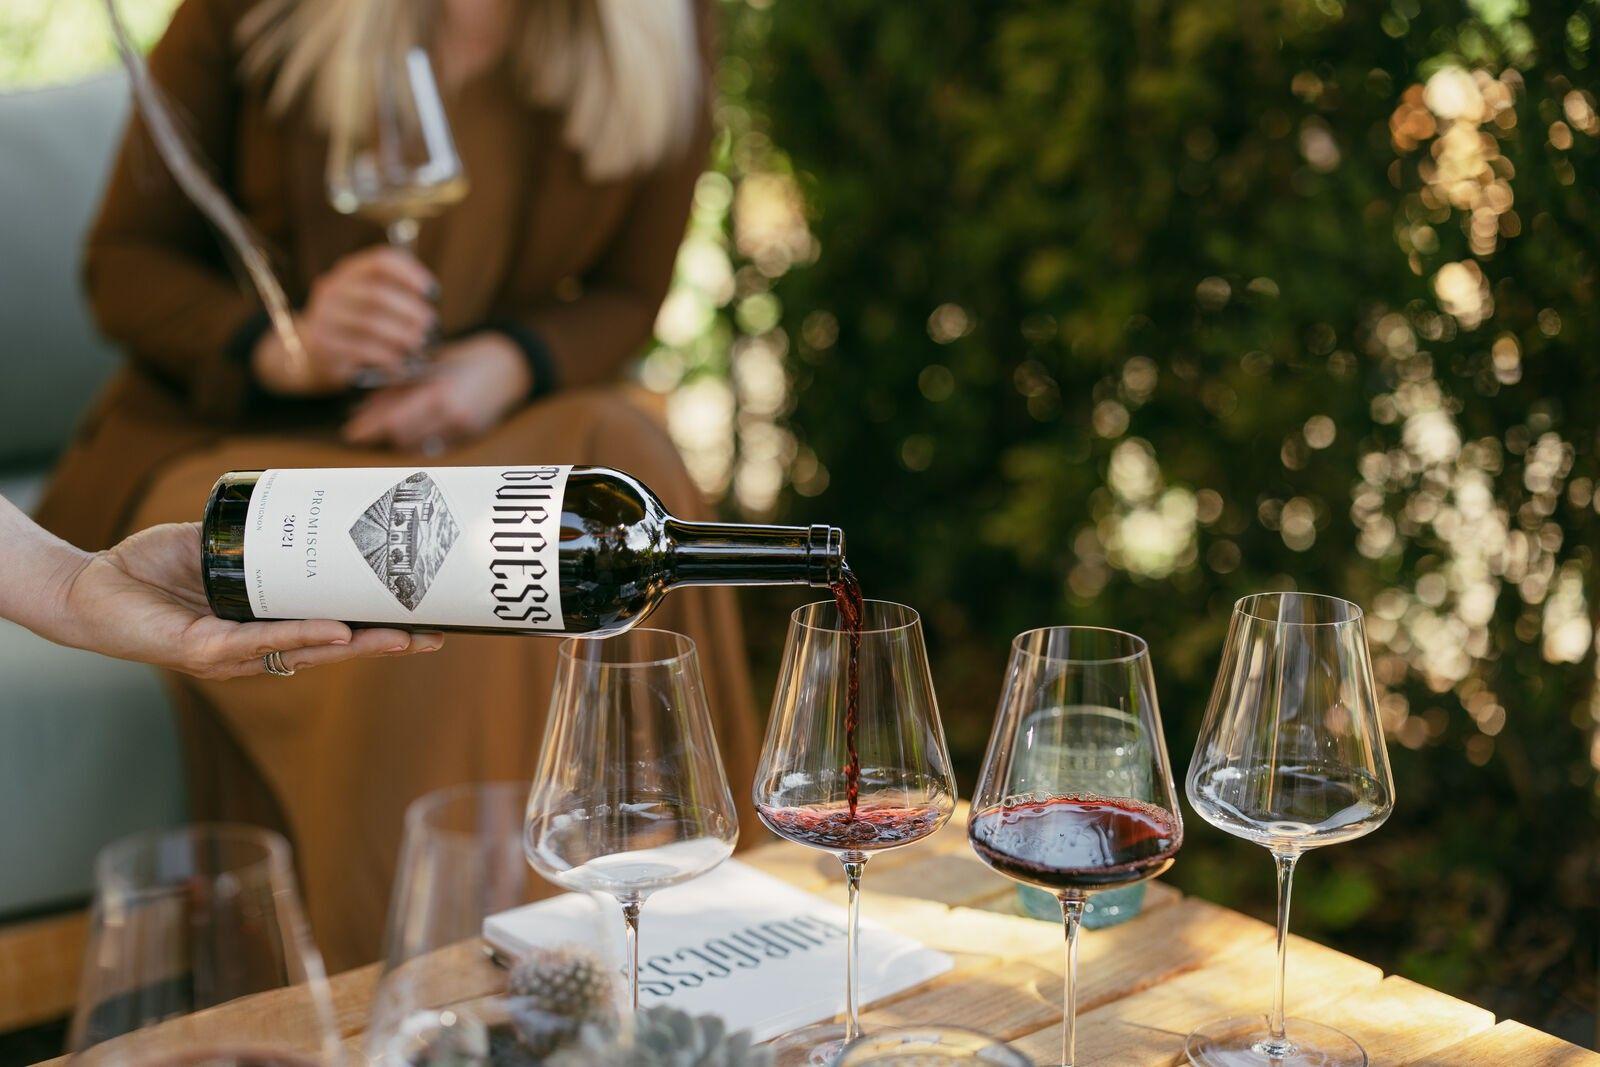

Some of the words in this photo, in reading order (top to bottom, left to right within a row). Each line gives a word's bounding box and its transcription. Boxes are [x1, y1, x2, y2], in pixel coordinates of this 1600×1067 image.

[281, 513, 297, 549] 2021
[305, 489, 325, 579] PROMISCUA
[489, 466, 560, 624] BURGESS
[256, 568, 264, 589] NAPA
[258, 590, 271, 613] VALLEY
